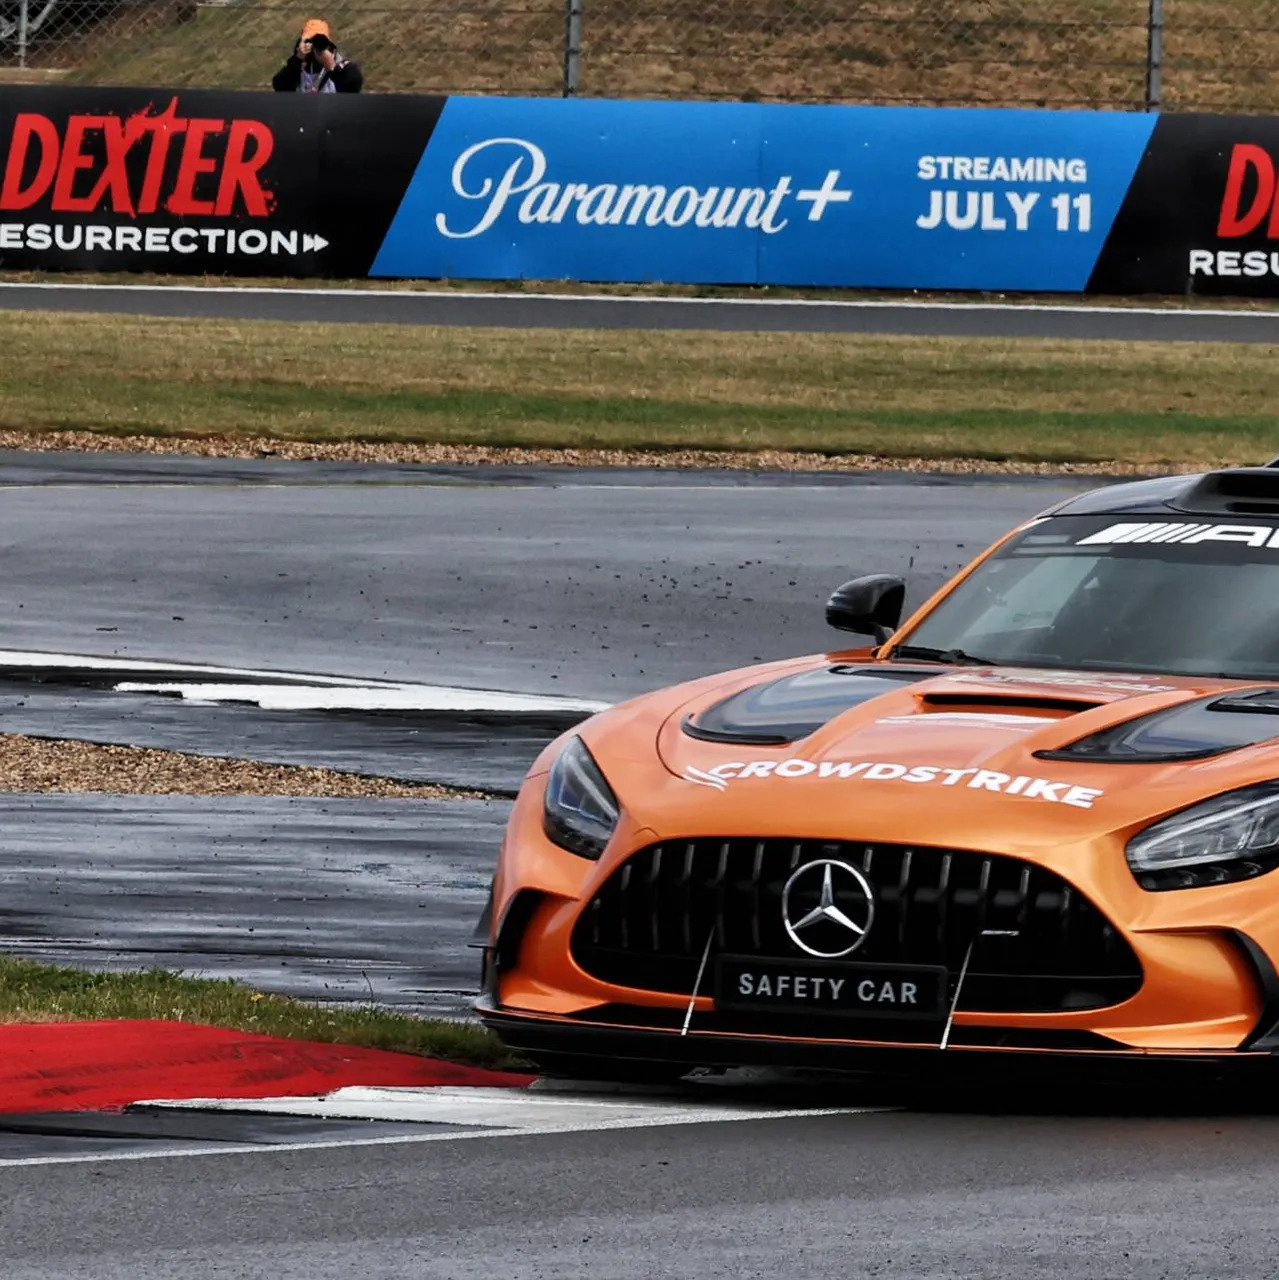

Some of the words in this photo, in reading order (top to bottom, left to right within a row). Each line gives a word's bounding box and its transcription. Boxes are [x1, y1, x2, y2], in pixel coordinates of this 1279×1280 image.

[0, 97, 276, 218] DEXTER
[918, 156, 1087, 183] STREAMING
[435, 138, 852, 238] Paramount+
[916, 191, 1038, 231] JULY
[1052, 193, 1091, 232] 11
[0, 223, 298, 255] ESURRECTION
[707, 759, 1104, 809] CROWDSTRIKE
[738, 973, 845, 999] SAFETY
[858, 980, 918, 1004] CAR
